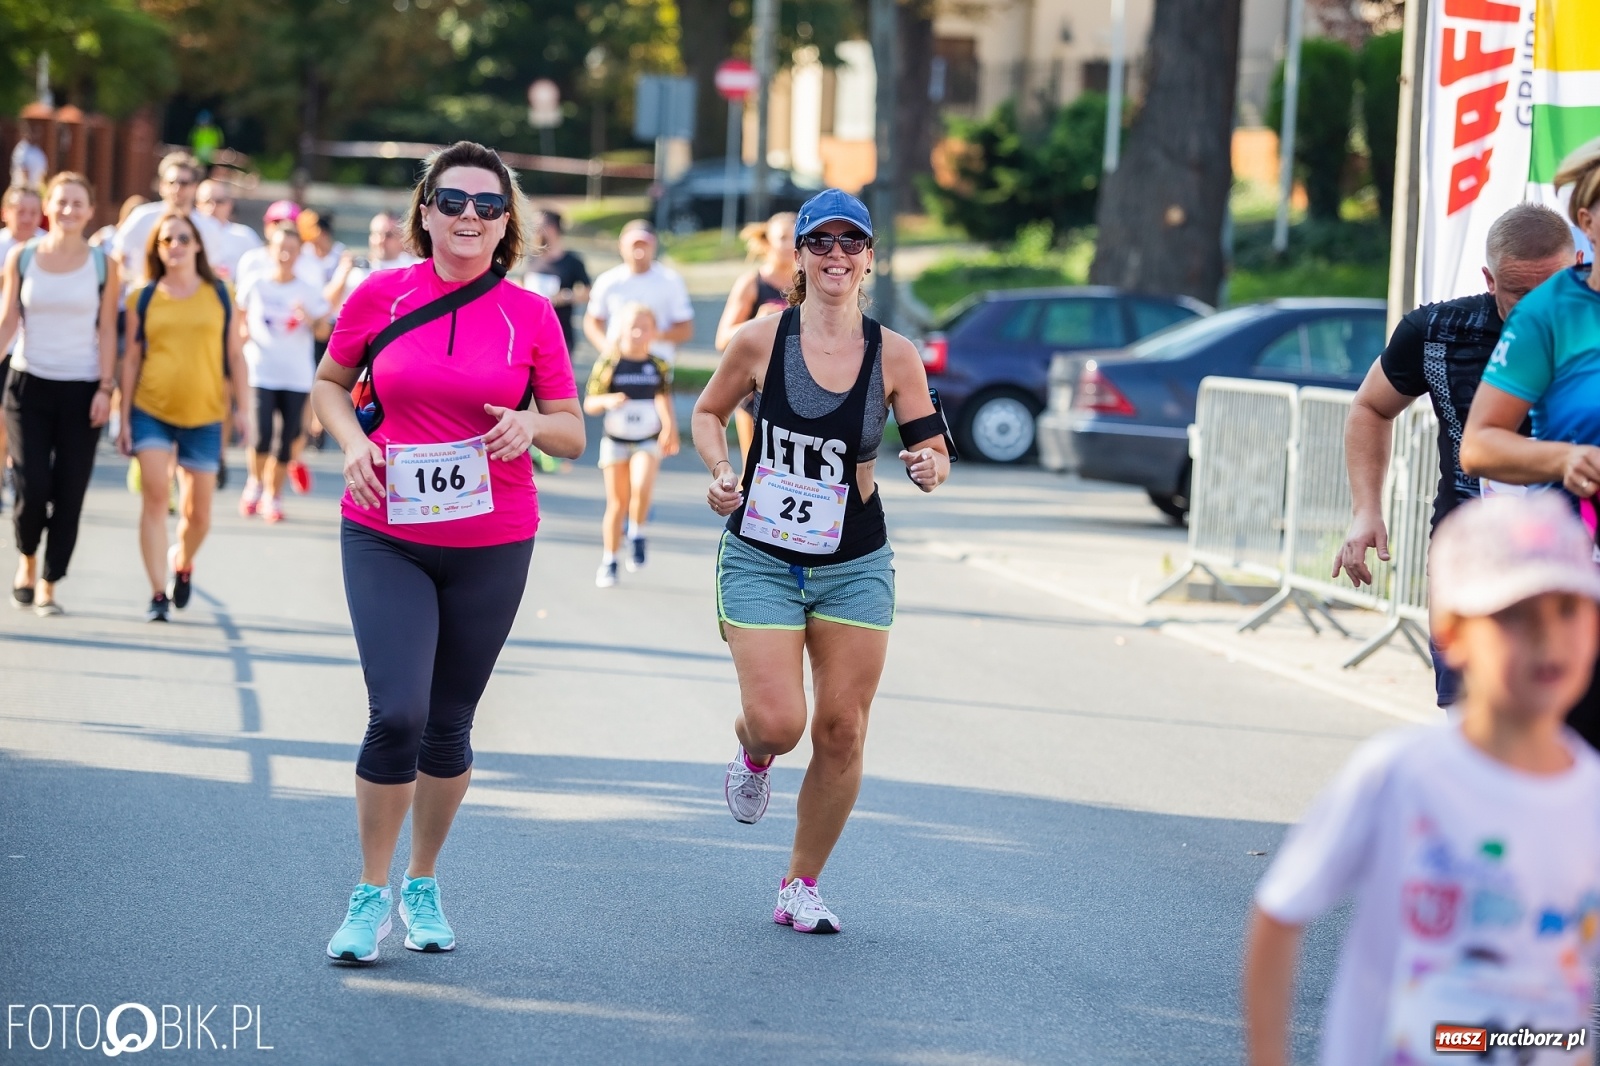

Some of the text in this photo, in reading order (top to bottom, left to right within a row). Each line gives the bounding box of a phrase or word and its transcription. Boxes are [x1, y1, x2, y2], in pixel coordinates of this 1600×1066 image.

[760, 418, 847, 484] LET'S
[415, 464, 465, 493] 166
[780, 496, 813, 524] 25
